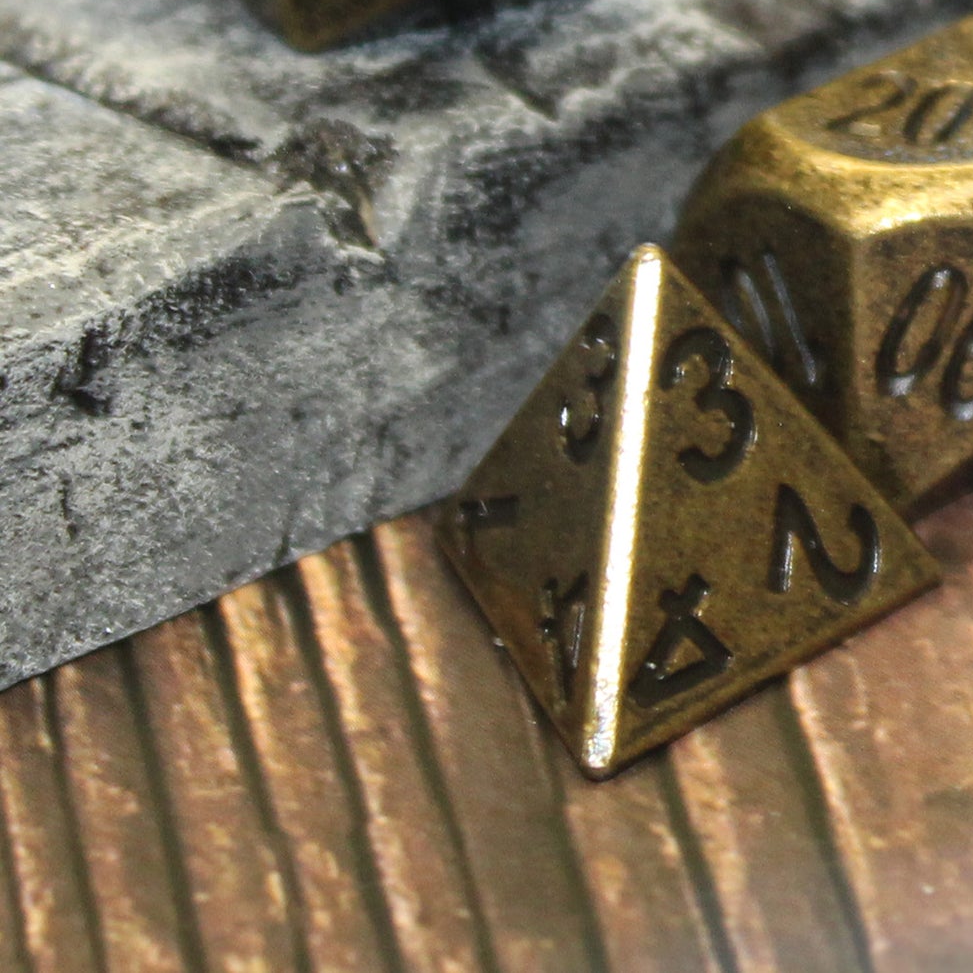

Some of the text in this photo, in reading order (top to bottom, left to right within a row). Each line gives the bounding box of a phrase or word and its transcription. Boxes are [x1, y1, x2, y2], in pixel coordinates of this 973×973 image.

[660, 327, 758, 487] 3
[766, 482, 884, 607] 2
[625, 572, 735, 713] 4
